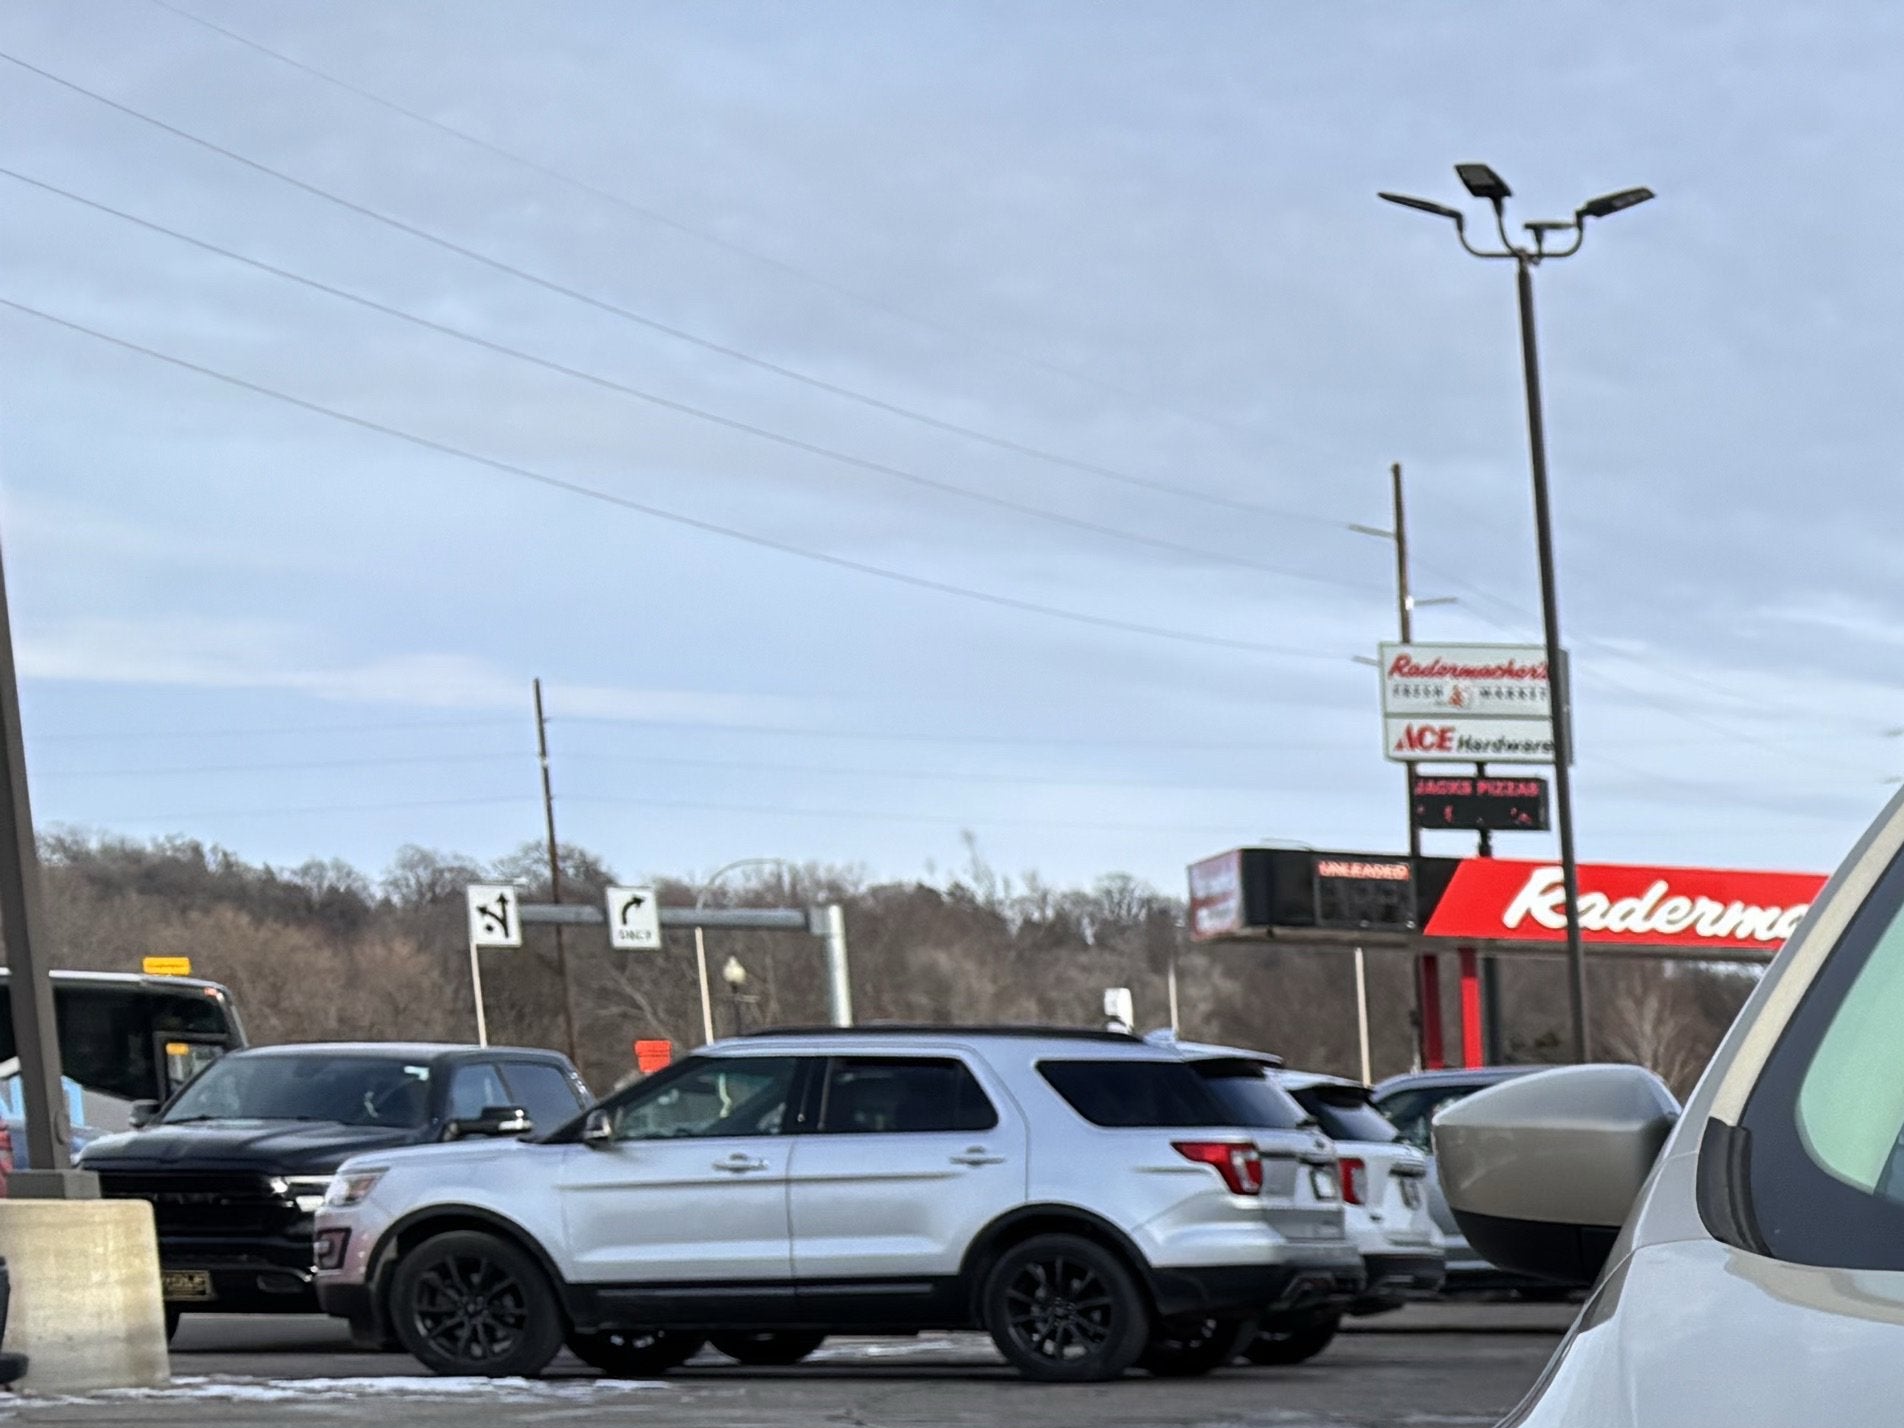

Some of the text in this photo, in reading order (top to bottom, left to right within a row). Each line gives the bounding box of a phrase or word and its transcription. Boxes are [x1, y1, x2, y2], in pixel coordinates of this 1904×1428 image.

[1395, 723, 1556, 754] ACE Hardware
[1318, 860, 1410, 880] UNLEADED
